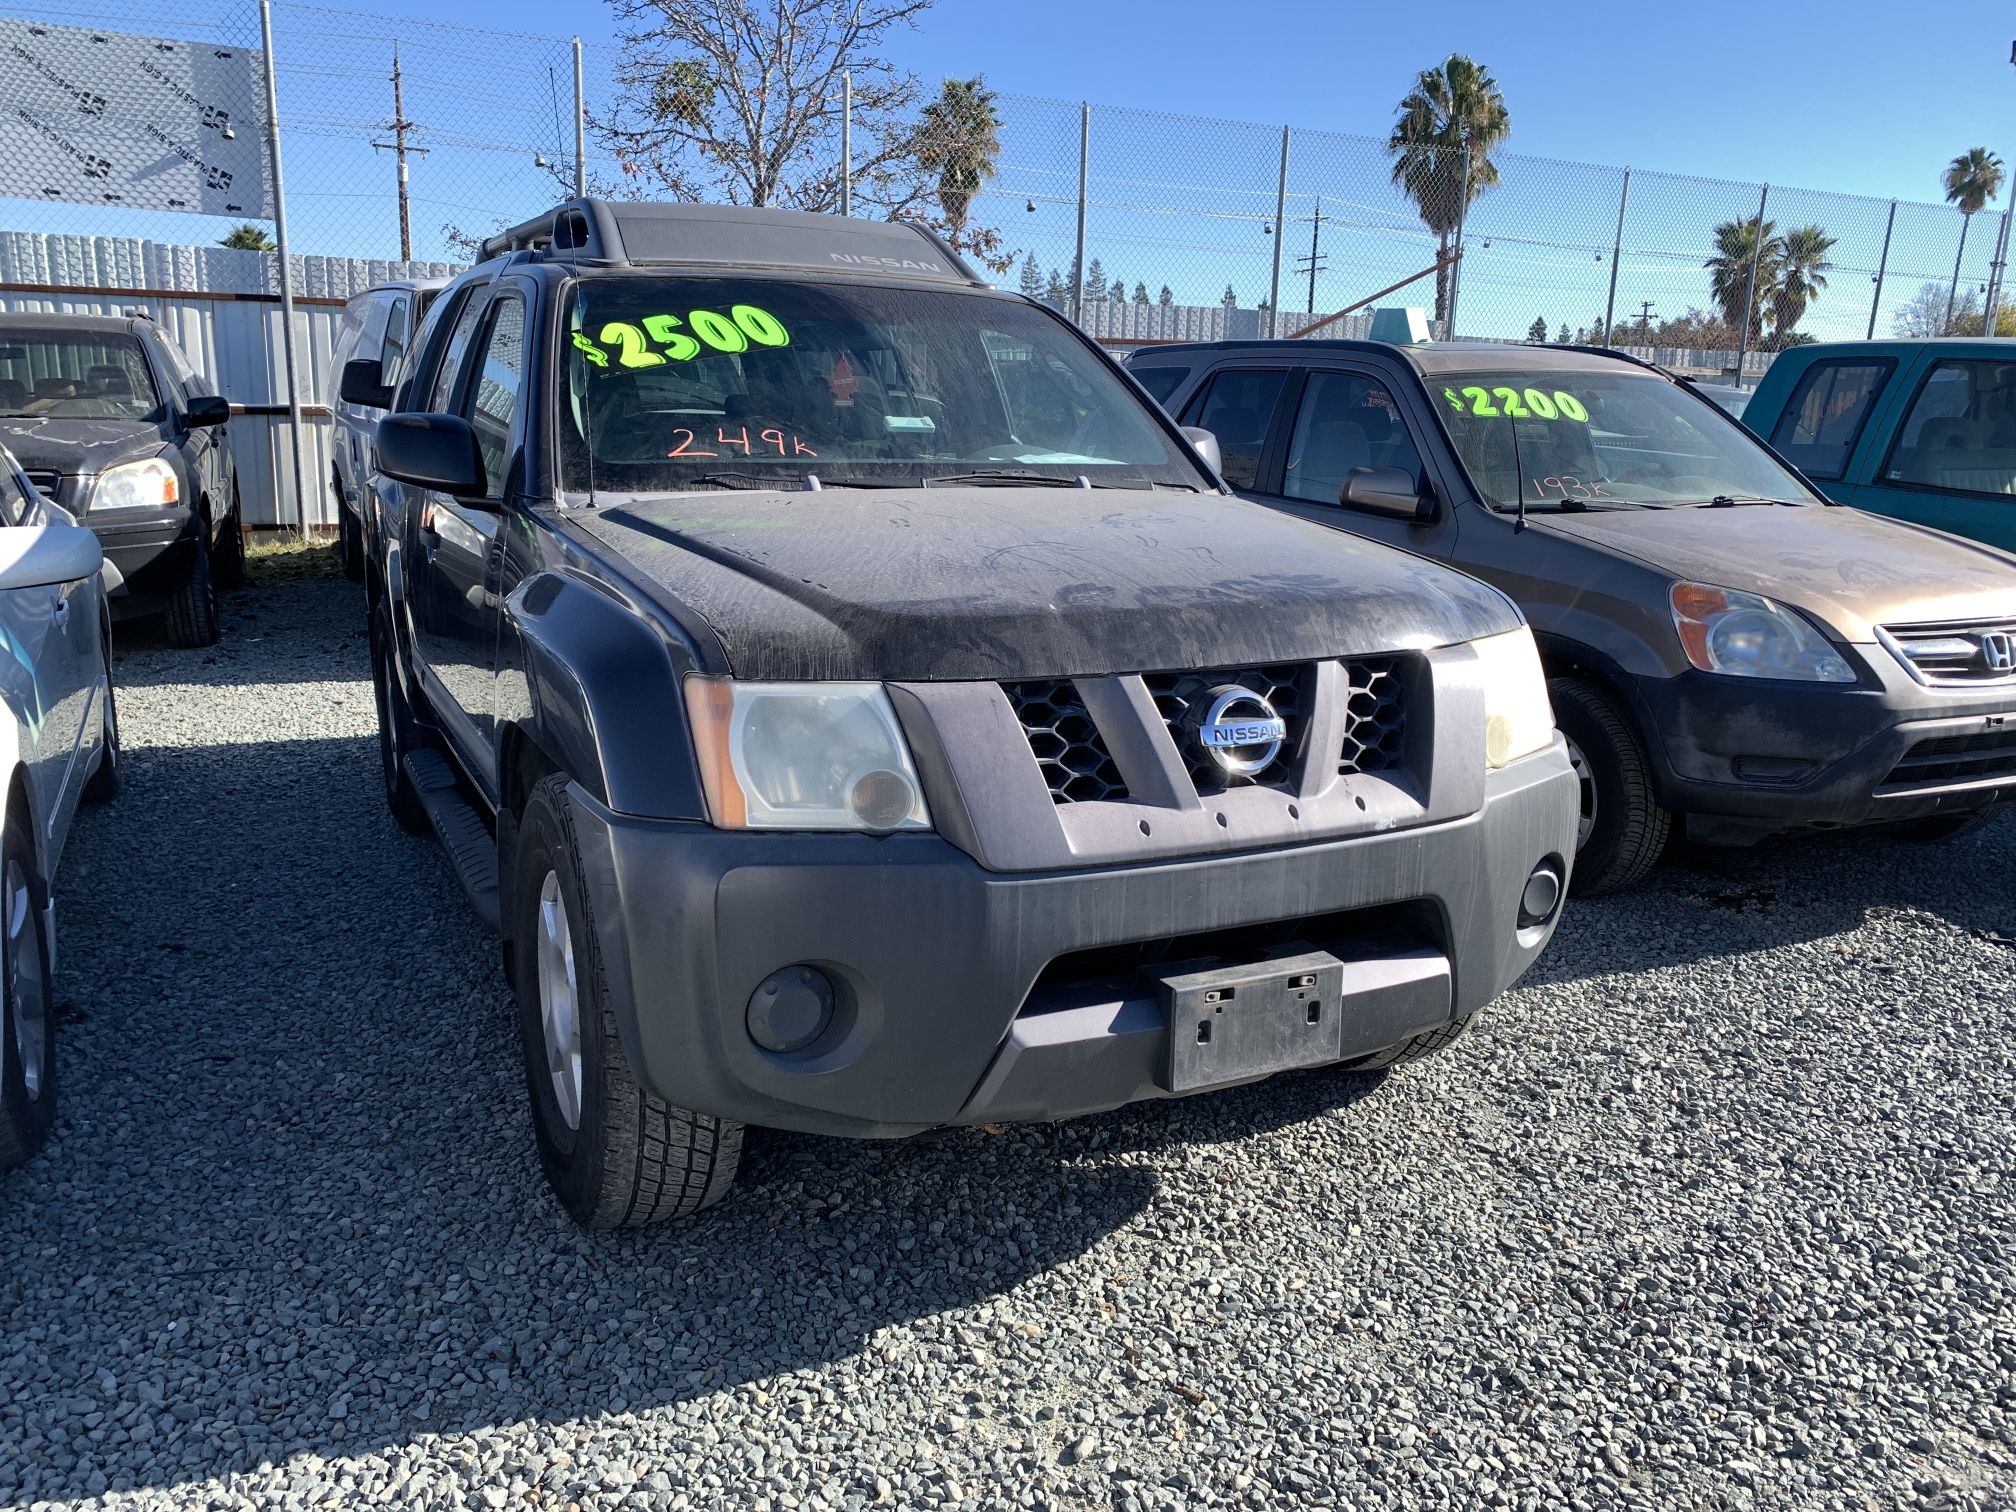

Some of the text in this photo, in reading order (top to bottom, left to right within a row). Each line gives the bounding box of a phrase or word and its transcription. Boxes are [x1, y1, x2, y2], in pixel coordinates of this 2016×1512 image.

[11, 44, 35, 64] SIGN
[140, 60, 162, 79] SIGN
[43, 68, 80, 99] PLASTIC
[170, 83, 206, 112] PLASTIC
[18, 109, 40, 129] SIGN
[146, 123, 167, 142] SIGN
[49, 133, 86, 162] PLASTIC
[174, 146, 210, 174] PLASTIC
[830, 252, 941, 272] NISSAN
[571, 304, 790, 369] $2500
[1444, 386, 1589, 422] $2200
[1213, 724, 1281, 743] NISSAN
